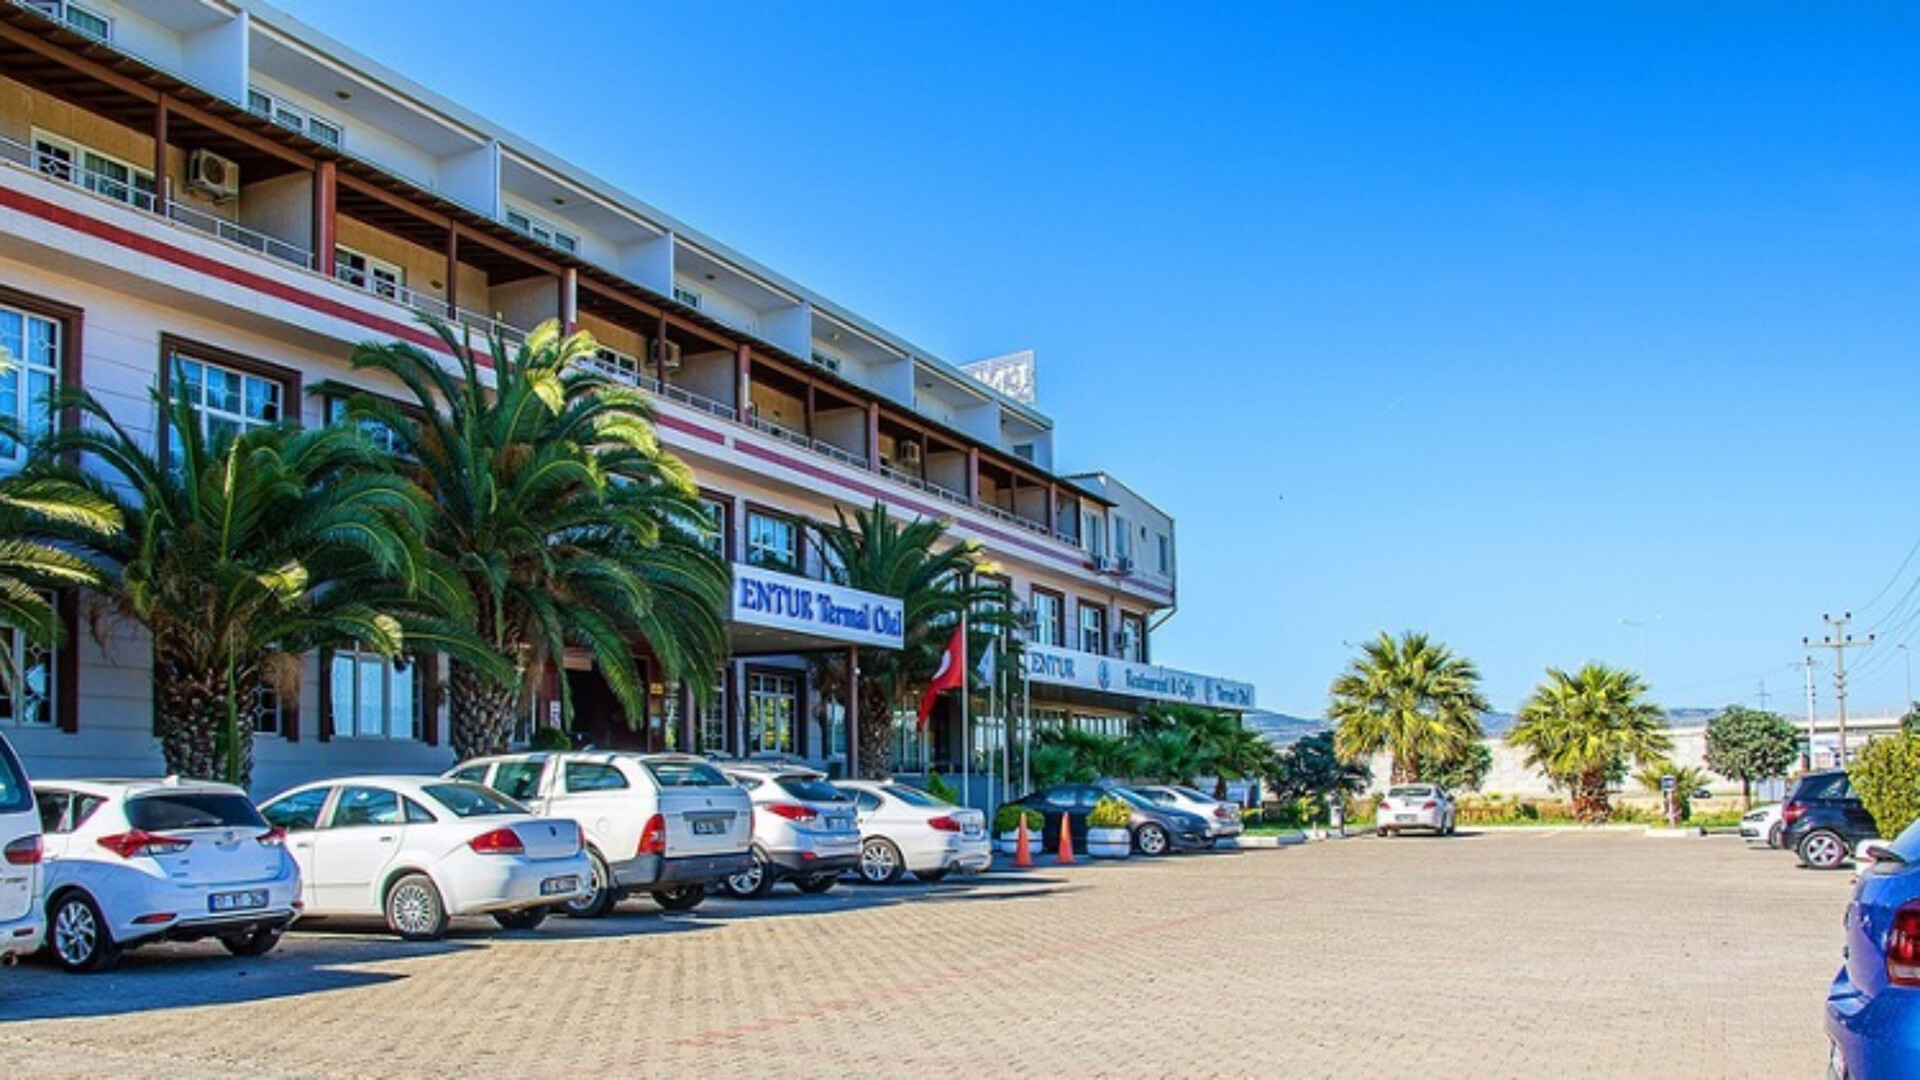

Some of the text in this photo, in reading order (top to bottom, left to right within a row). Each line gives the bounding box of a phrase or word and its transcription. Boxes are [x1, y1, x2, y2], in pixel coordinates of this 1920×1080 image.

[740, 578, 813, 620] ENTUR
[817, 594, 869, 630] Termal
[1032, 652, 1076, 679] ENTUR
